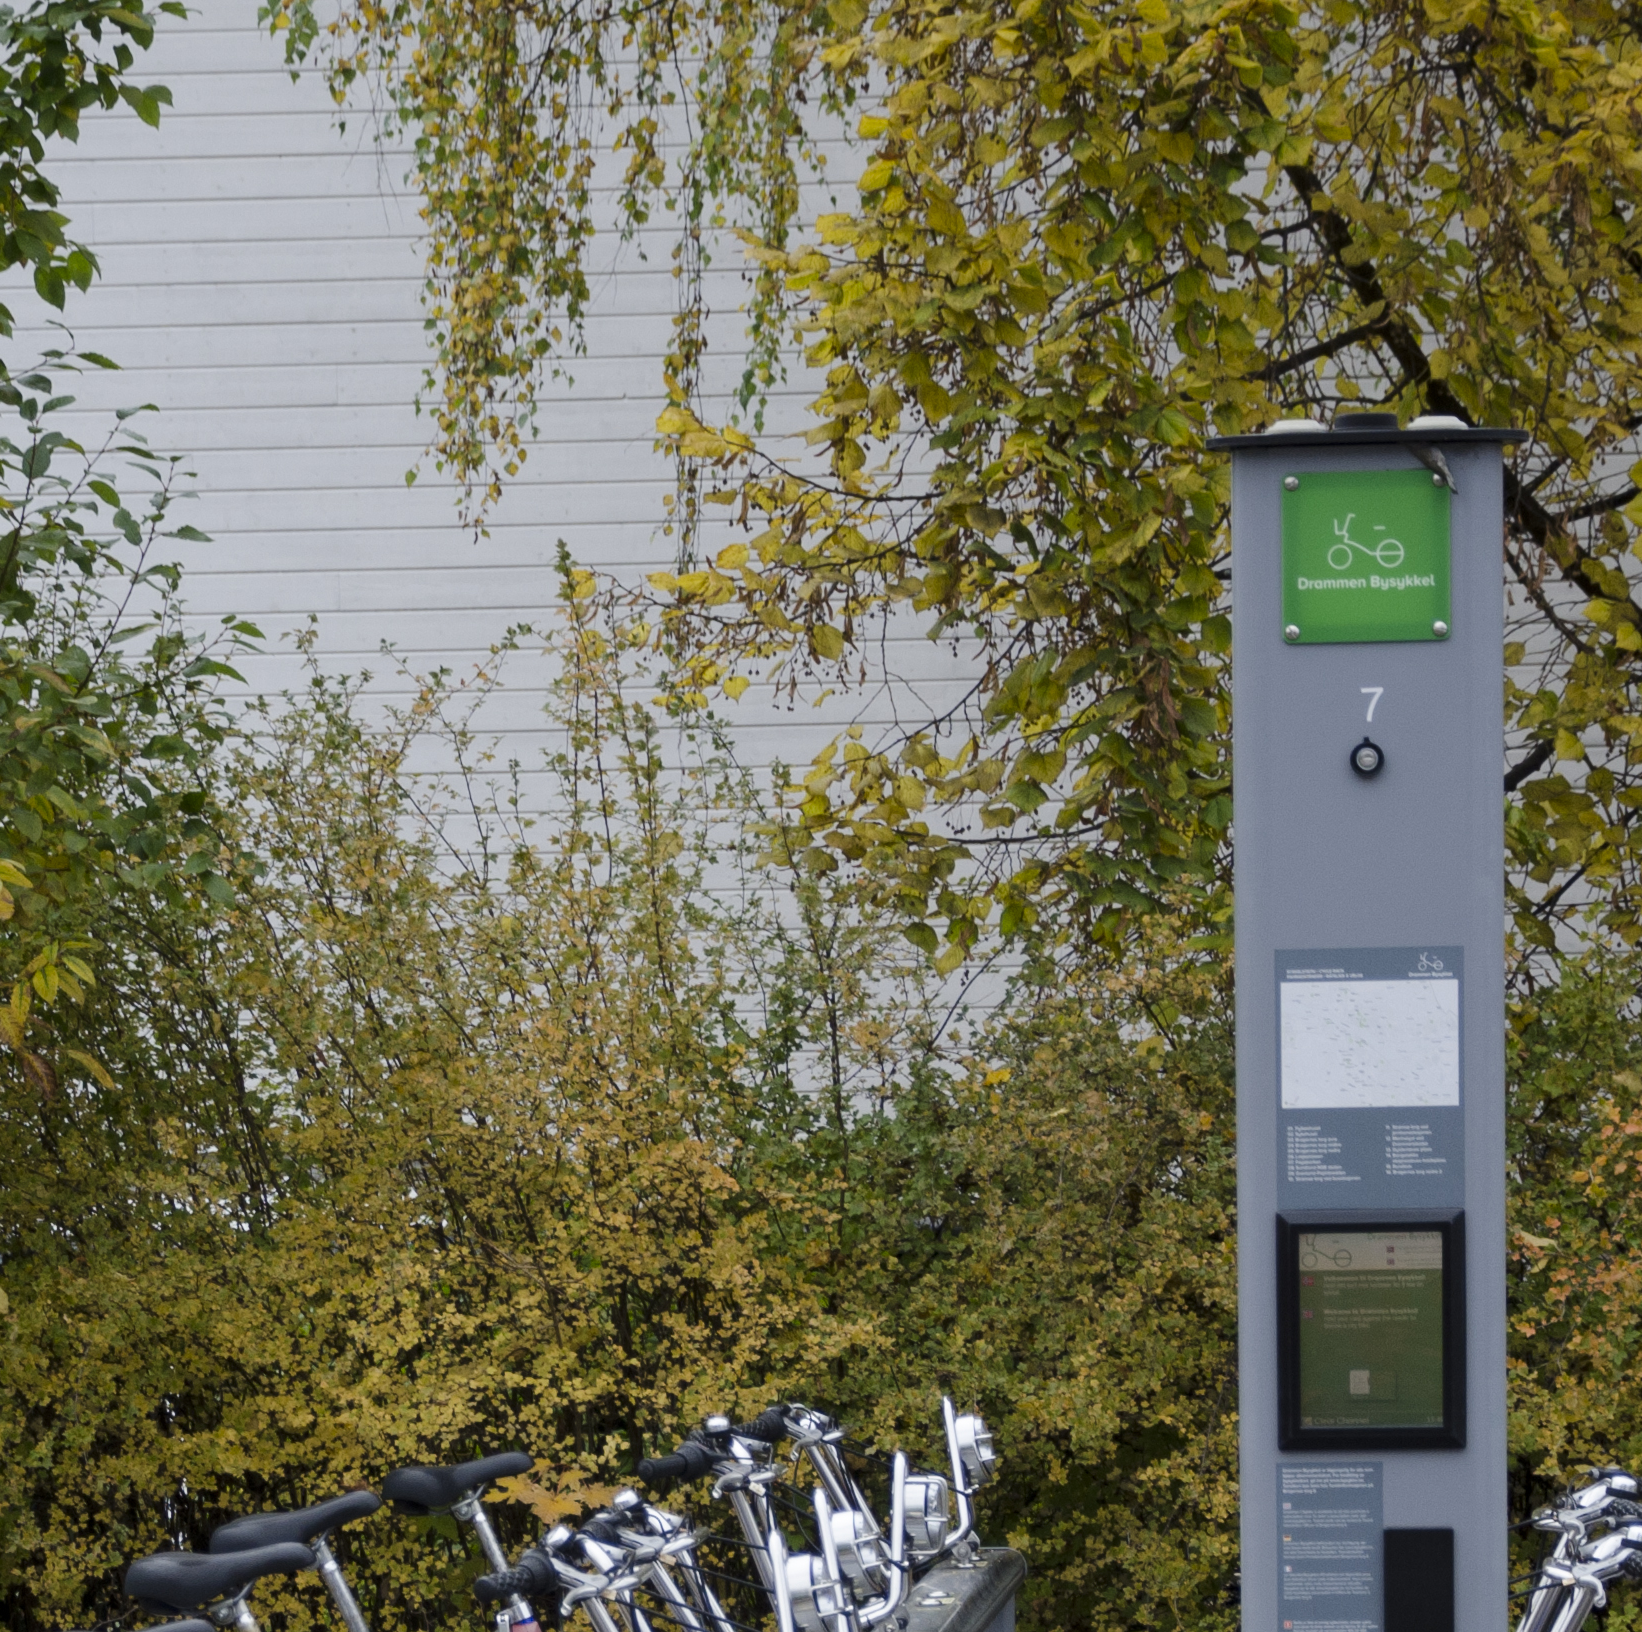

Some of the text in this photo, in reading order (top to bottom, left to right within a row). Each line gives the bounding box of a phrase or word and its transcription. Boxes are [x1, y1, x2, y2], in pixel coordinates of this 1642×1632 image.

[1298, 574, 1435, 590] Drammen Bysykkel
[1360, 687, 1384, 722] 7
